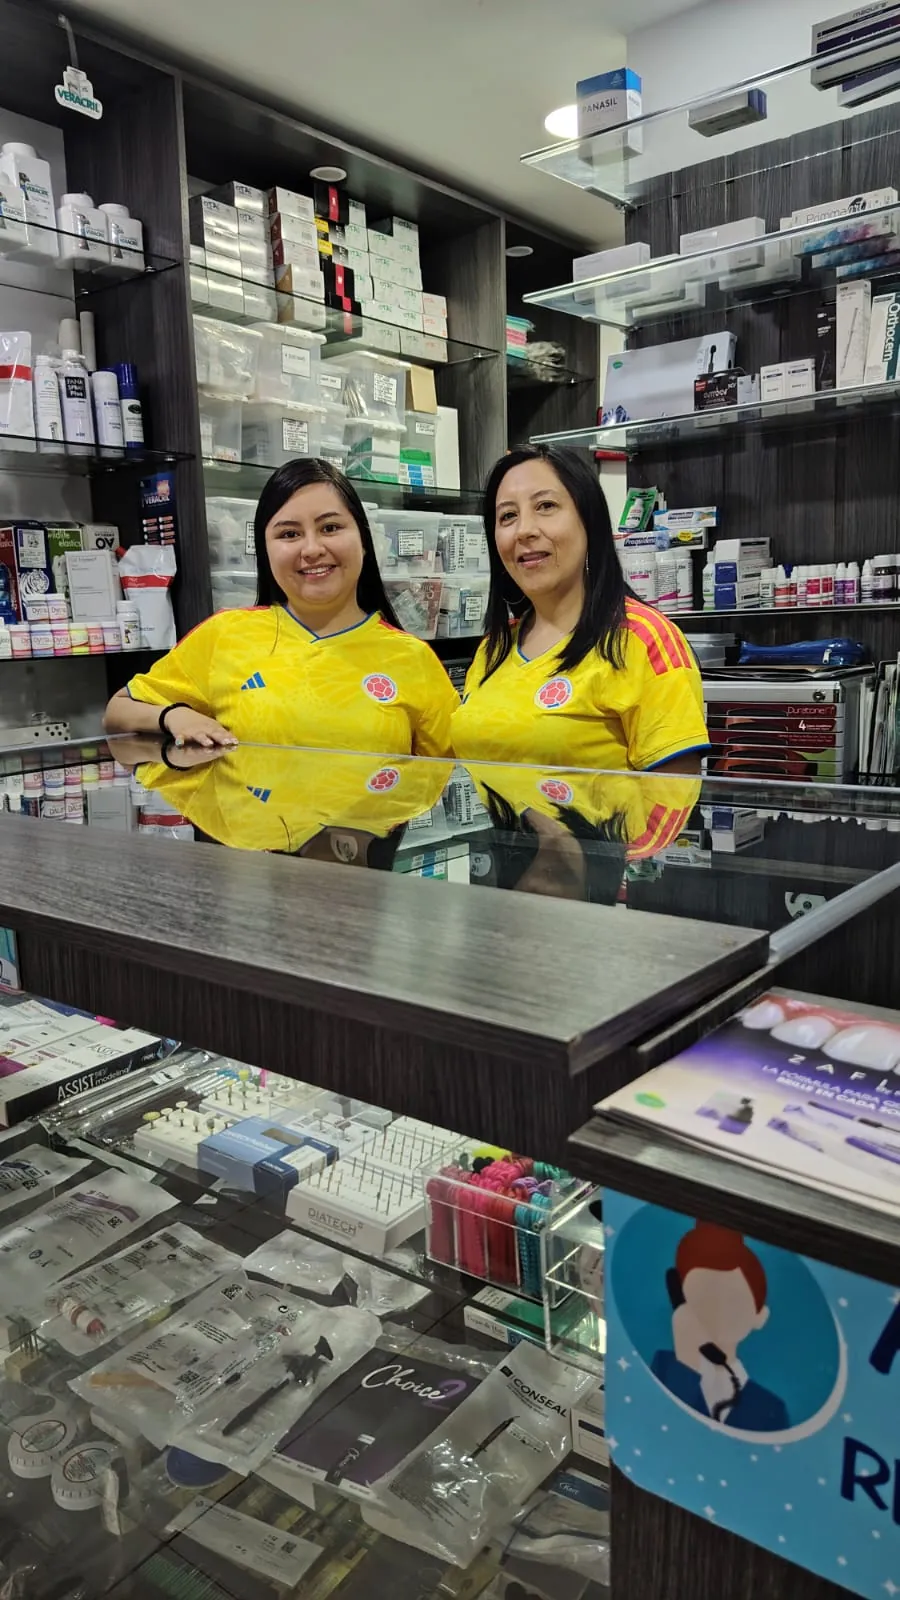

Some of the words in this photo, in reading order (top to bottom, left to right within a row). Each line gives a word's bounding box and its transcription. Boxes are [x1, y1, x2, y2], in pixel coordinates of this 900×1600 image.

[57, 87, 100, 113] VERACRIL
[583, 97, 617, 112] PANASIL
[882, 302, 900, 362] Orthocem
[798, 719, 807, 731] 4
[57, 1073, 95, 1102] ASSIST
[308, 1207, 357, 1236] DIATECH
[361, 1365, 446, 1400] Choice
[513, 1377, 567, 1417] CONSEAL
